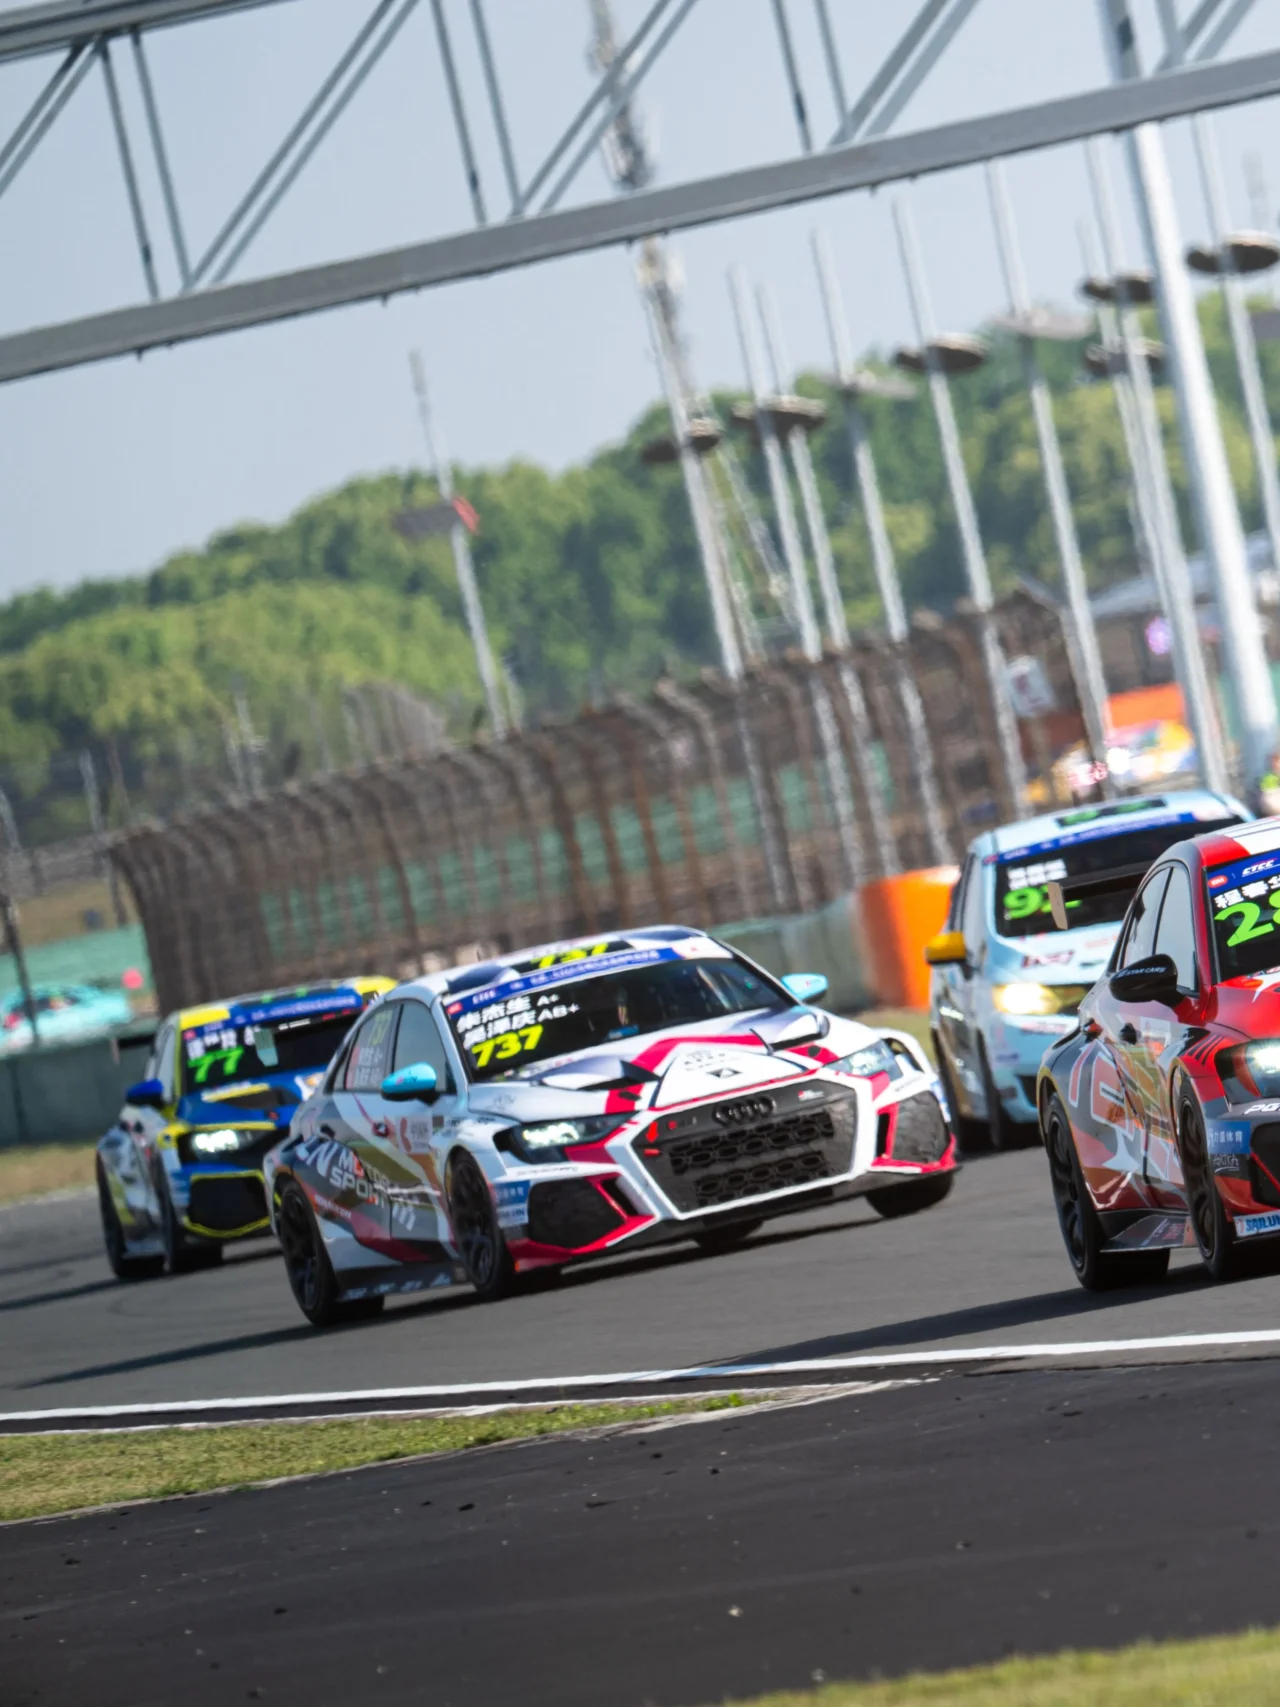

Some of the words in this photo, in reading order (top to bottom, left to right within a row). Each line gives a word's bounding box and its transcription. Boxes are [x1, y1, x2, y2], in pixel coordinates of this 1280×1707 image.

[1242, 859, 1275, 875] CTCC
[530, 942, 609, 970] 737
[470, 1025, 543, 1068] 737
[188, 1046, 243, 1082] 77
